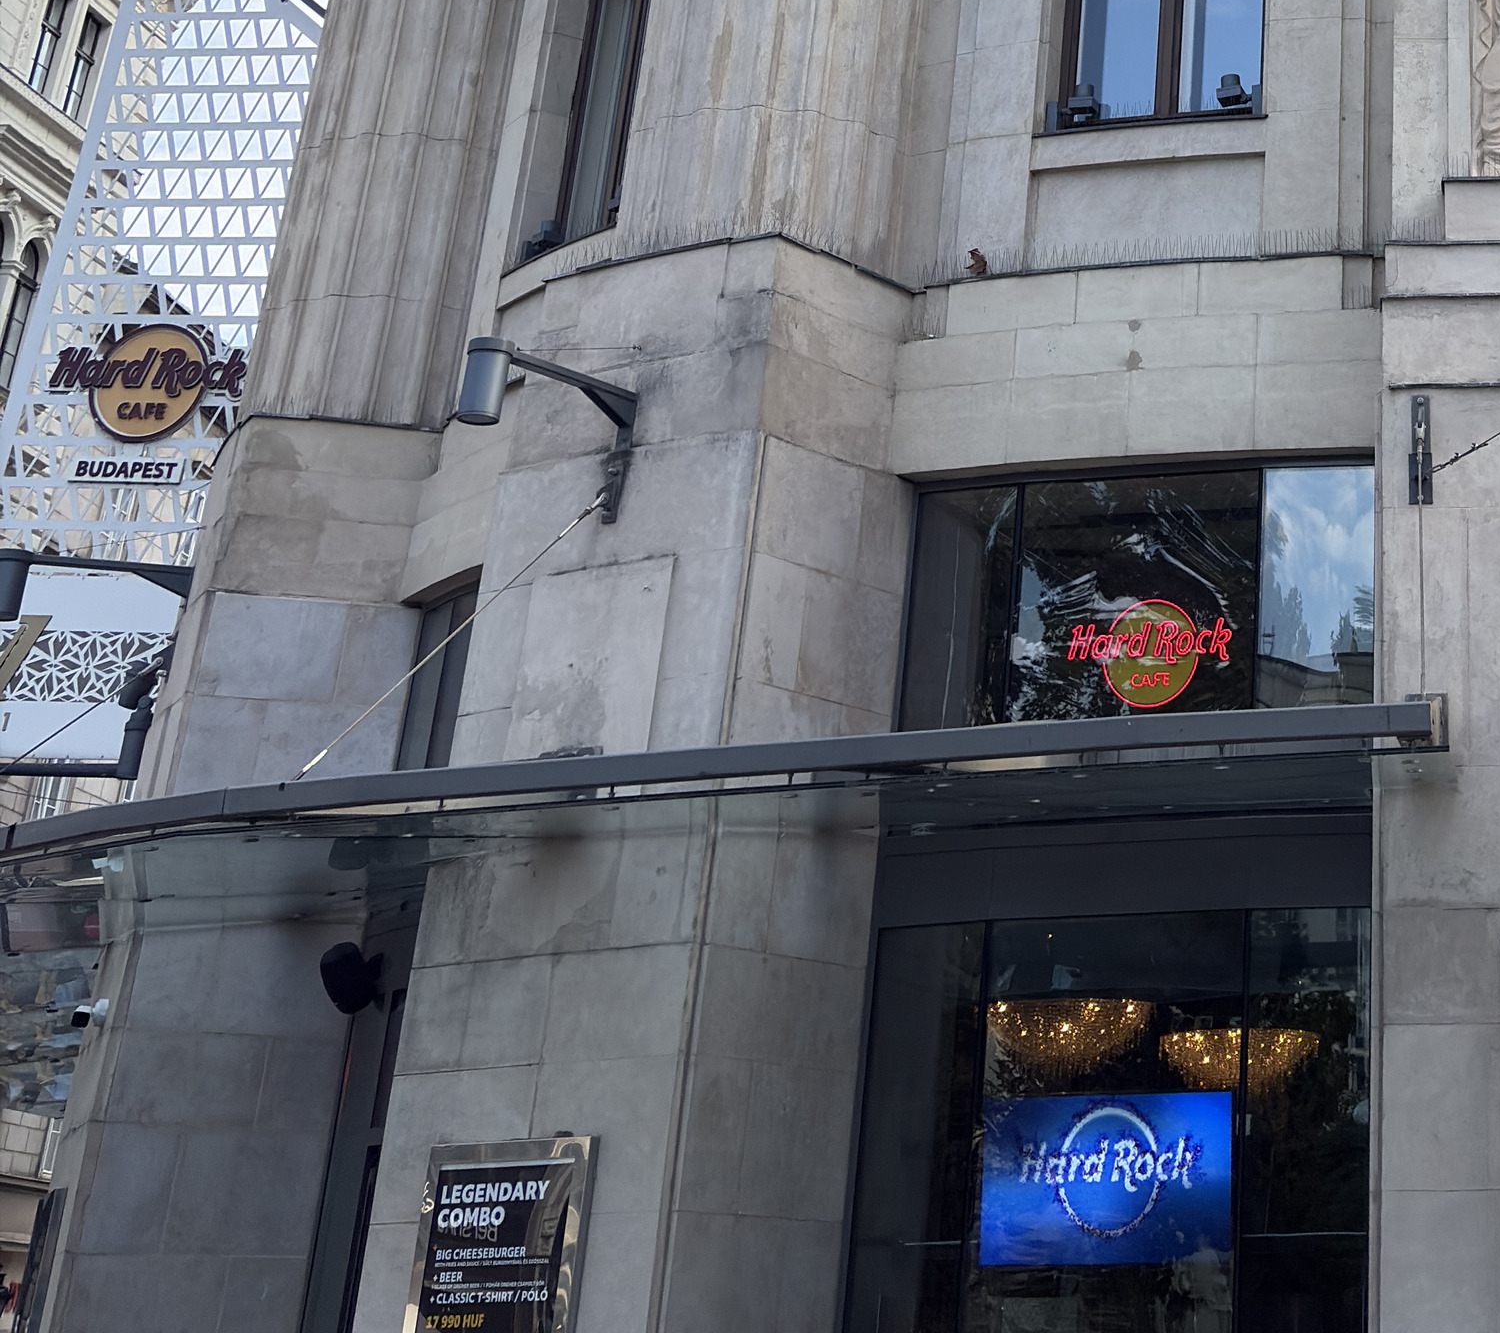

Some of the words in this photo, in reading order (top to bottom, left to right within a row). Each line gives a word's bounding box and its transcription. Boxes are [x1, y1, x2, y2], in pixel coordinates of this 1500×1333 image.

[49, 346, 160, 389] Hard
[151, 347, 247, 398] Rock
[116, 401, 169, 421] CAFE
[74, 460, 178, 479] BUDAPEST
[1066, 621, 1152, 662] Hard
[1153, 617, 1233, 665] Rock
[1130, 672, 1171, 688] CAFE
[1019, 1138, 1109, 1184] Hard
[1111, 1136, 1195, 1193] Rock
[440, 1180, 551, 1205] LEGENDARY
[437, 1205, 506, 1229] COMBO
[435, 1249, 452, 1261] BIG
[453, 1246, 526, 1260] CHEESEBURGER
[439, 1271, 463, 1283] BEER
[436, 1292, 475, 1305] CLASSIC
[477, 1291, 514, 1303] T-SHIRT
[514, 1290, 521, 1303] /
[521, 1287, 548, 1302] PÓLÓ
[425, 1315, 440, 1329] 17
[441, 1314, 461, 1329] 990
[462, 1313, 485, 1328] HUF
